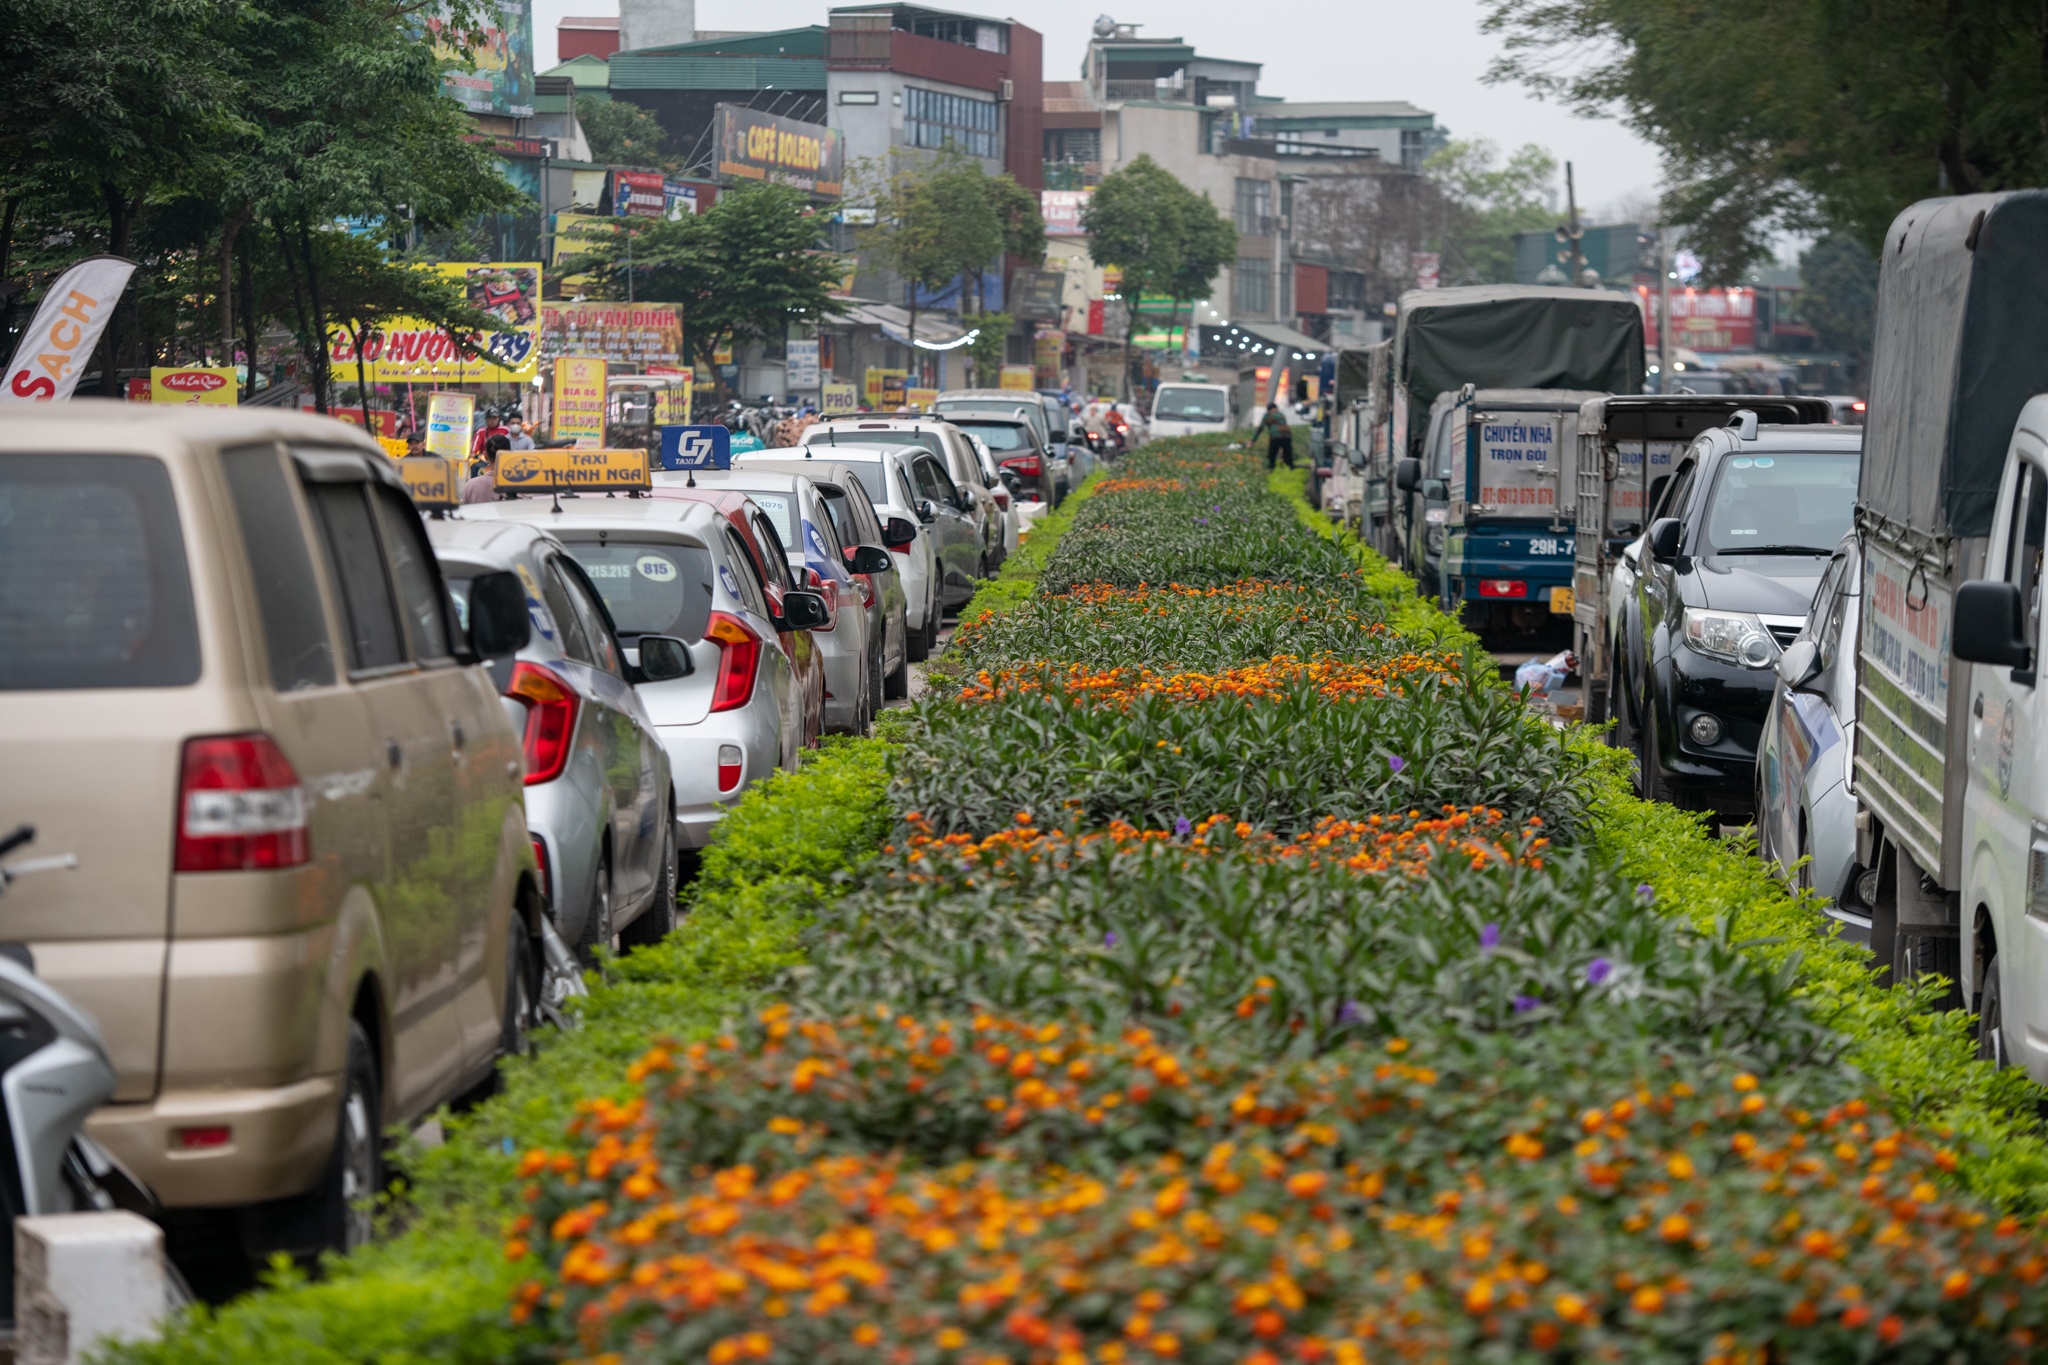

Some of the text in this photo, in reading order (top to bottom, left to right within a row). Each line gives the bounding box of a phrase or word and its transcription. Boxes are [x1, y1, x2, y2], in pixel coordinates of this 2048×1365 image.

[748, 122, 776, 163] CAFÉ
[777, 131, 820, 171] BOLERO
[11, 289, 98, 403] SẠCH
[332, 332, 386, 363] LU
[563, 387, 580, 397] BIA
[1484, 421, 1553, 444] CHUYỂN NHÀ
[677, 430, 713, 465] G7
[1491, 447, 1547, 464] TRỌN GÓI
[571, 454, 608, 465] TAXI
[543, 468, 641, 482] THANH NGA
[760, 501, 784, 510] 1075
[1529, 538, 1576, 555] 29H-7
[643, 563, 668, 575] 815
